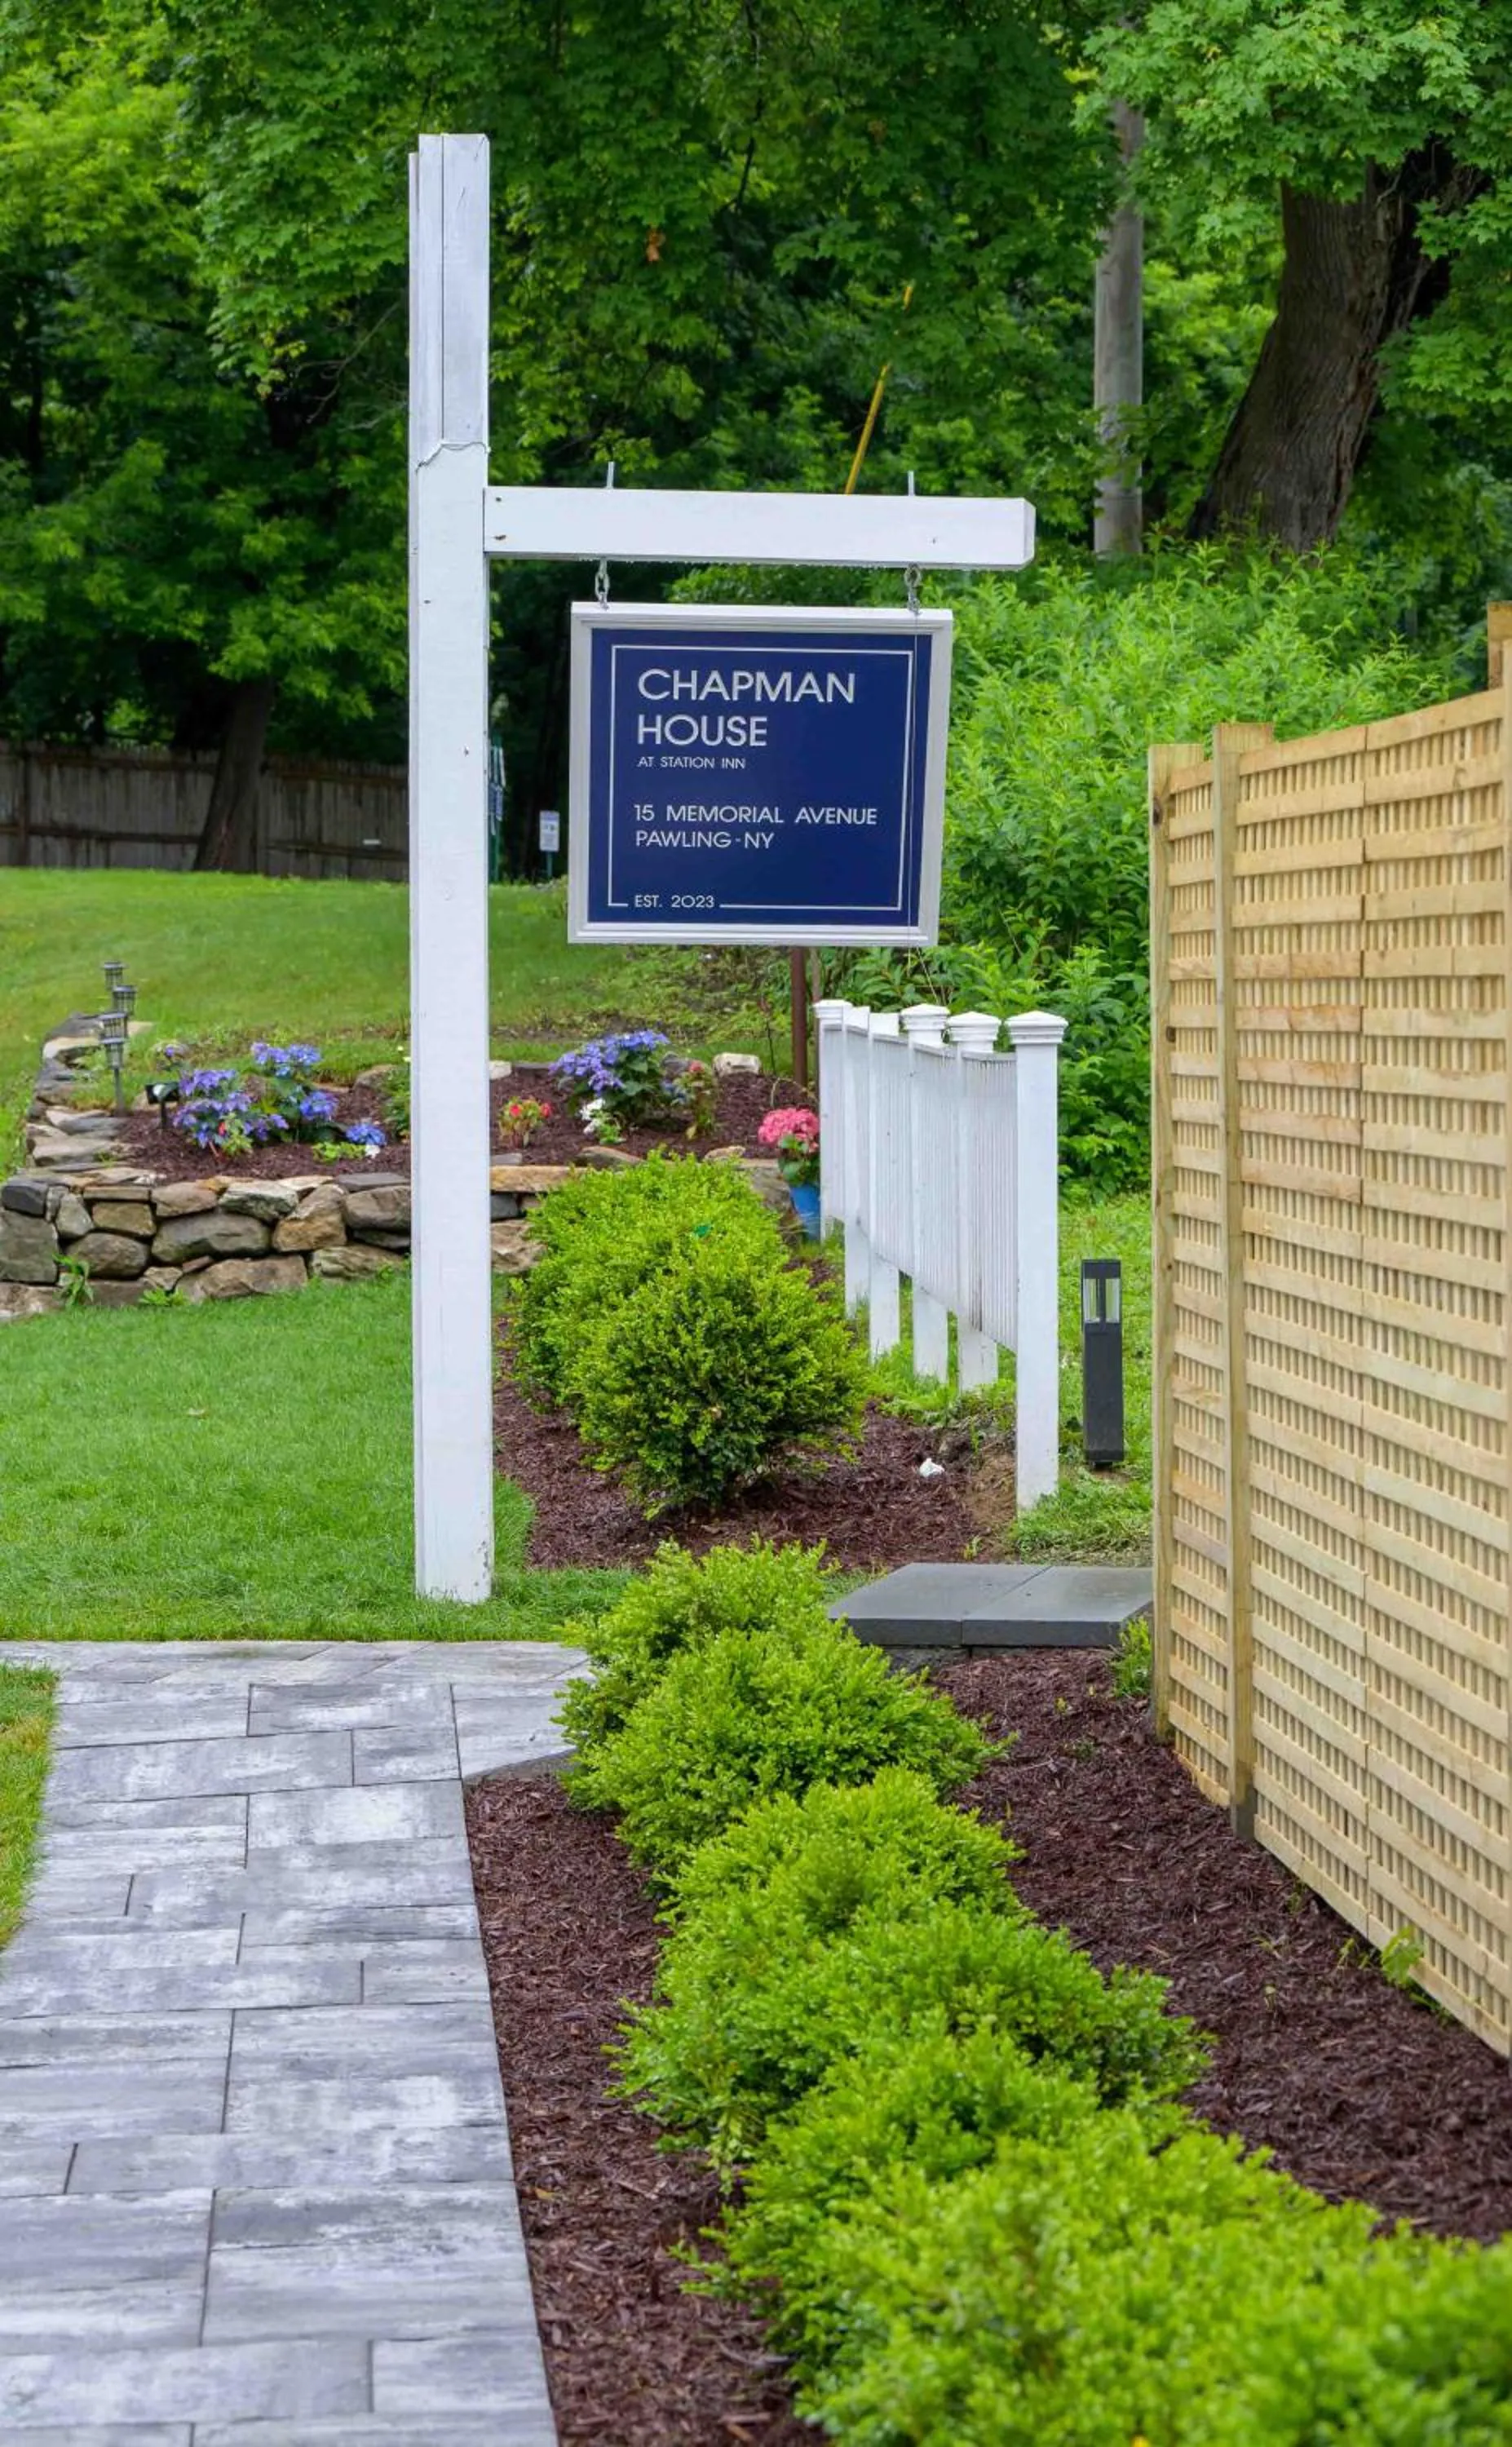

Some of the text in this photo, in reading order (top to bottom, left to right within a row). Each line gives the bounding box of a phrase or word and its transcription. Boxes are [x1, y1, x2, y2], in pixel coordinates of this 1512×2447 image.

[637, 668, 855, 702] CHAPMAN
[637, 715, 768, 746] HOUSE
[638, 756, 746, 769] AT STATION INN
[634, 804, 878, 825] 15 MEMORIAL AVENUE
[635, 895, 715, 908] EST. 2023
